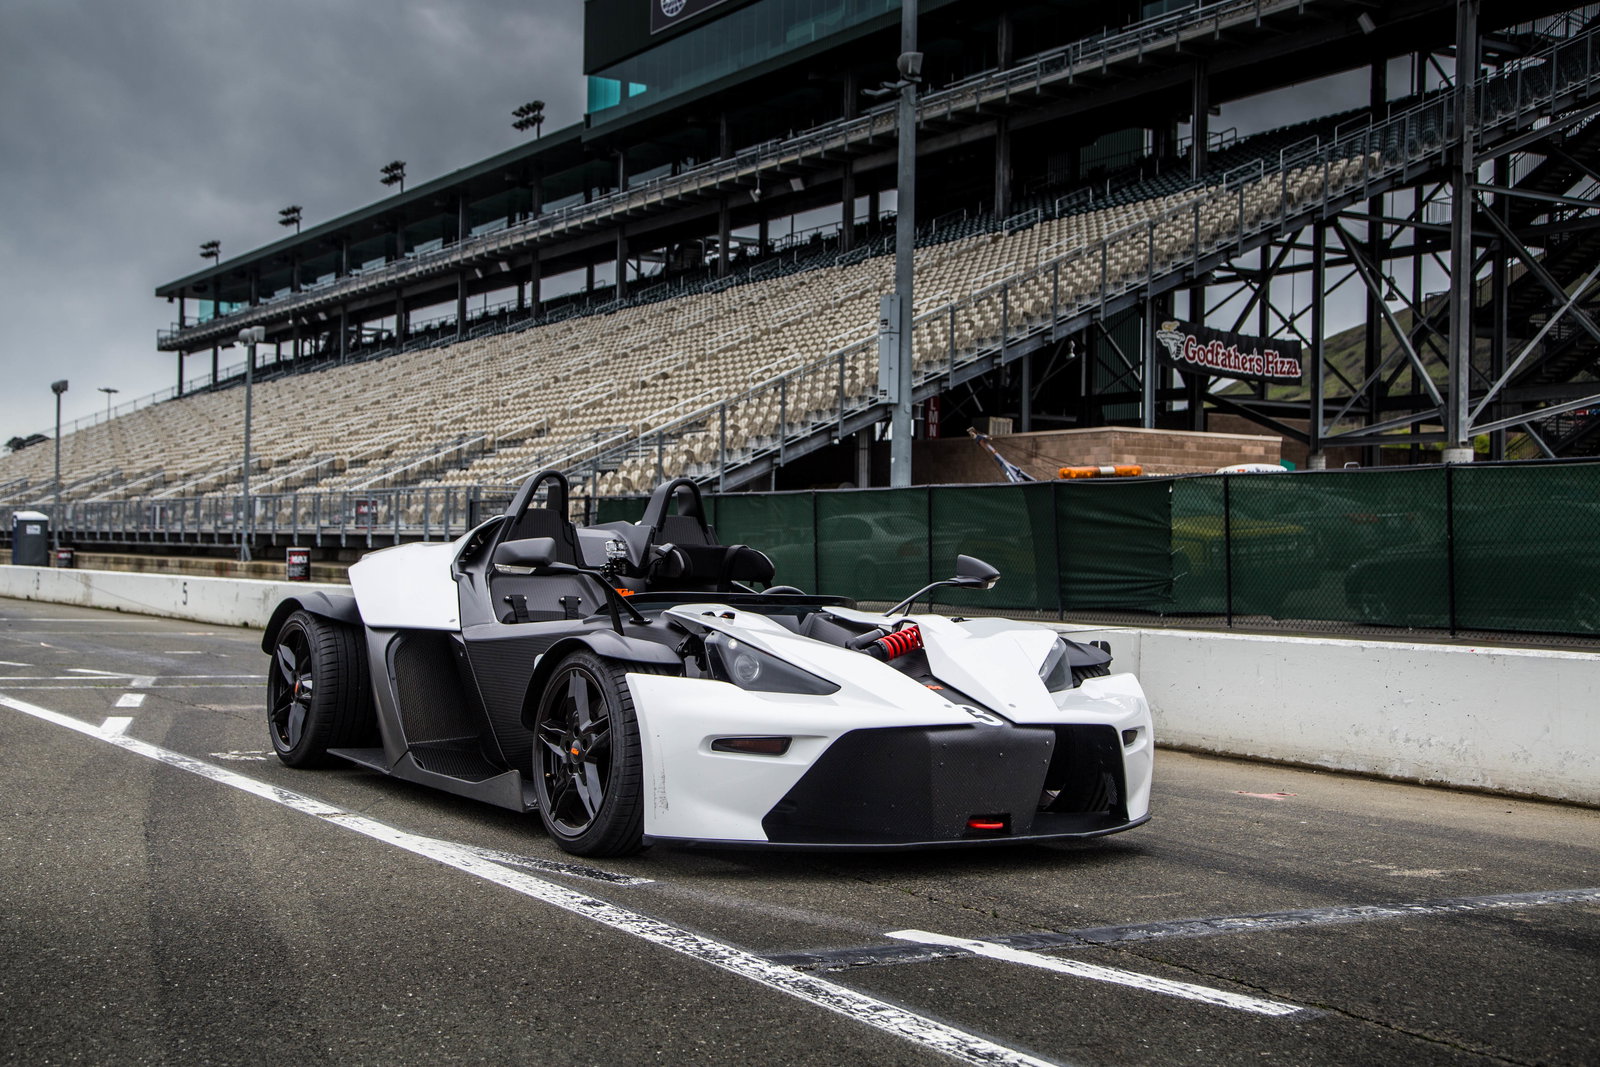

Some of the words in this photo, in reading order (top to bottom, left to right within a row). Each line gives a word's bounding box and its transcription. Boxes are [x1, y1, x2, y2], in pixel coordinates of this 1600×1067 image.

[1184, 335, 1263, 374] Godfather's
[1264, 349, 1301, 377] Pizza
[183, 582, 188, 605] 5
